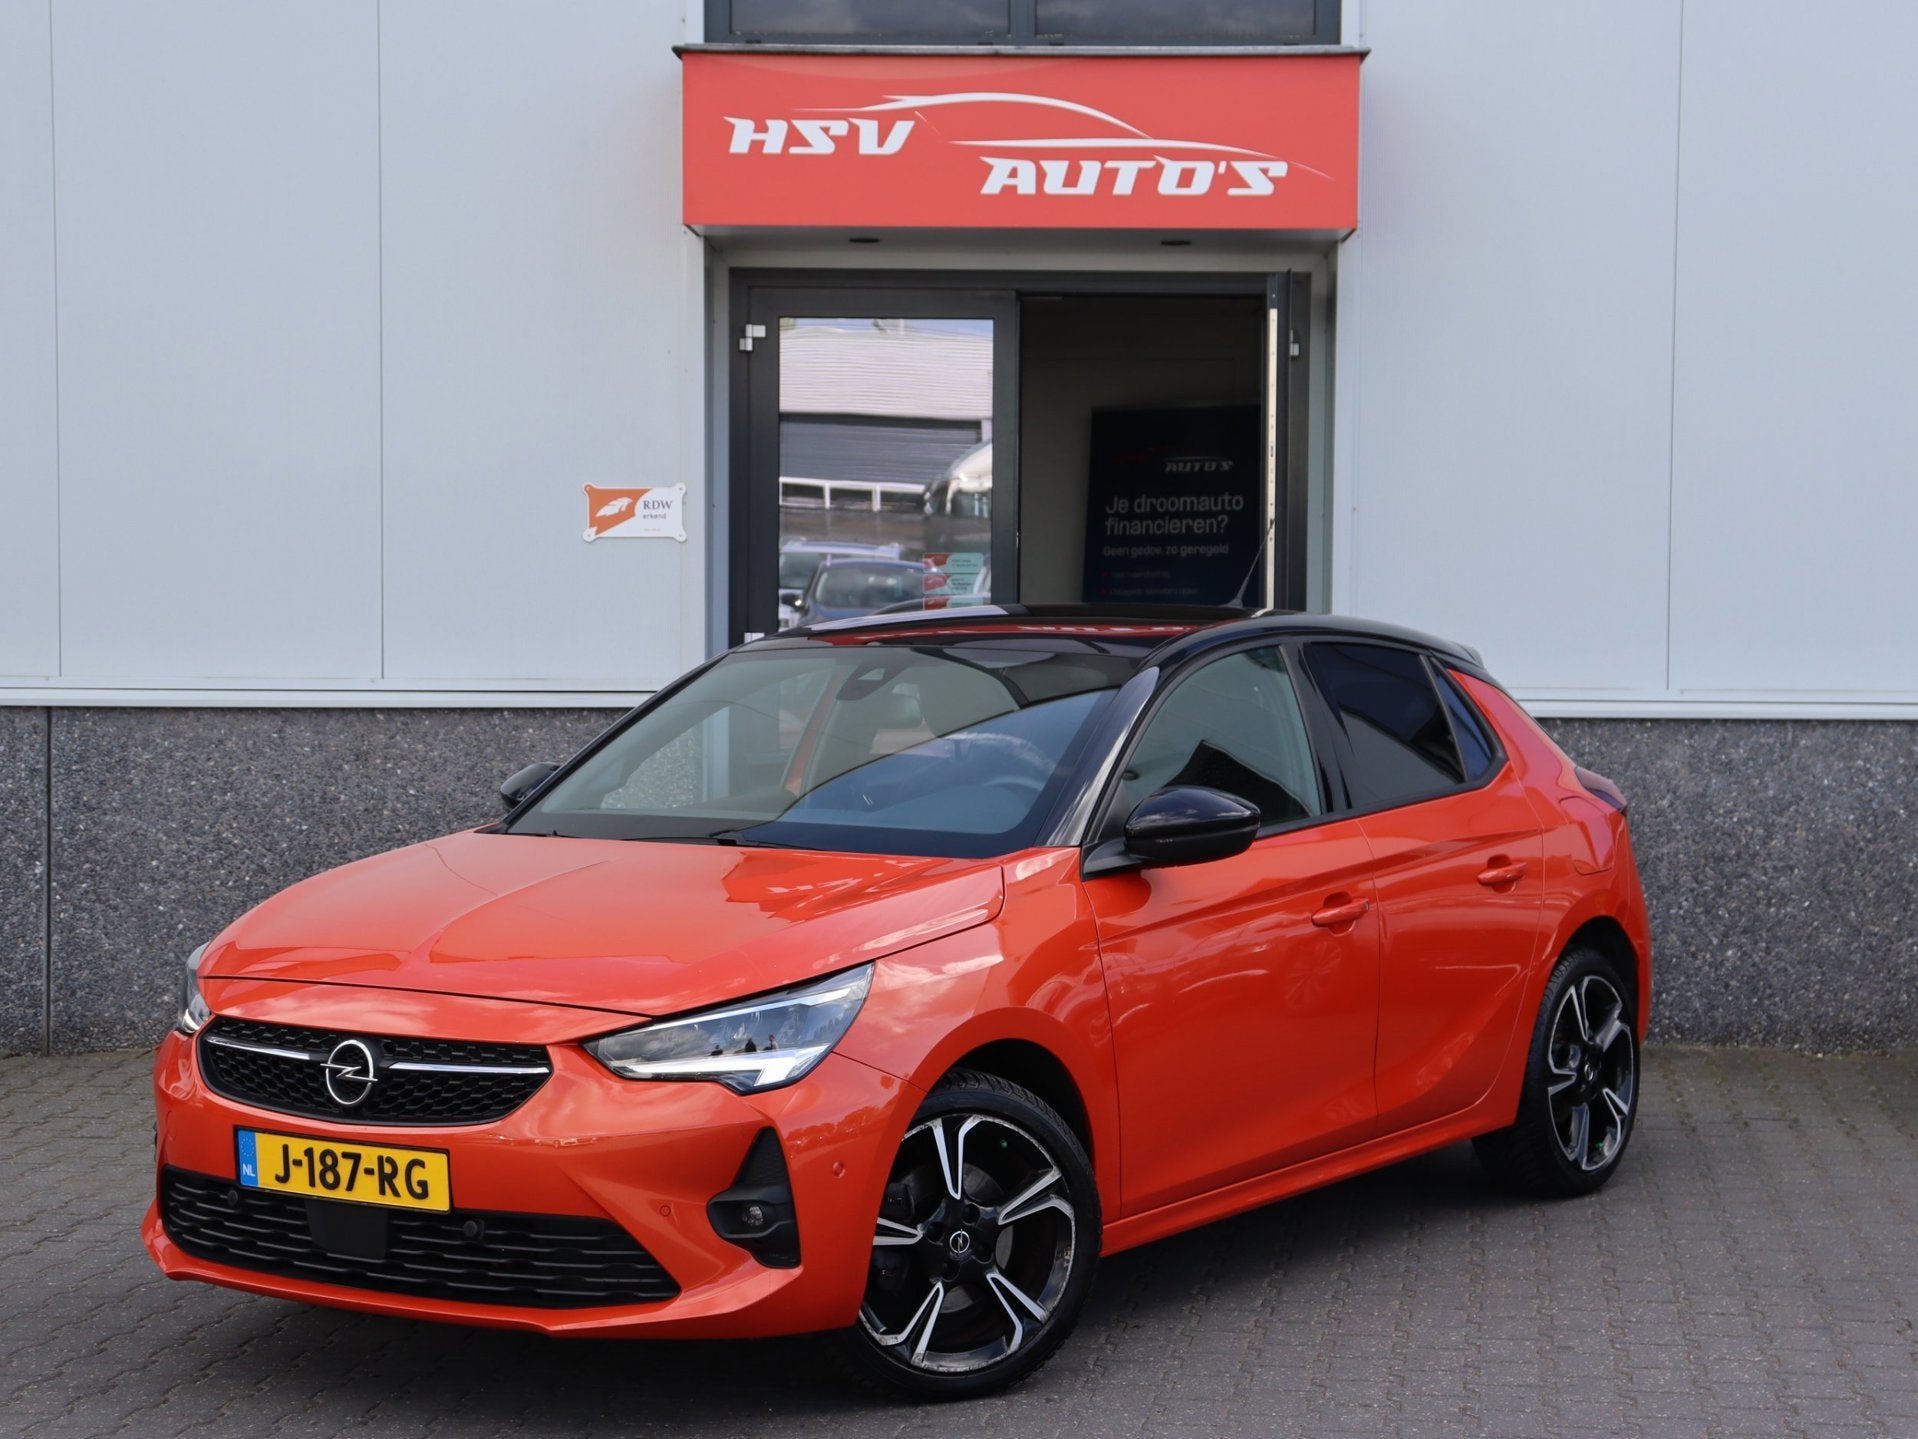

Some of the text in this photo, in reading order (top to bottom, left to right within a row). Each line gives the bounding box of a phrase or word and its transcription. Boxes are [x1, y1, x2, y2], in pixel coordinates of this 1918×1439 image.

[723, 116, 915, 155] HSV
[979, 155, 1289, 196] AUTO'S
[643, 500, 673, 510] RDW
[1105, 492, 1244, 514] Je droomauto
[1105, 515, 1229, 536] financieren?
[1103, 545, 1129, 556] Geen
[1180, 544, 1229, 557] geregeld
[242, 1163, 256, 1177] NL
[274, 1143, 429, 1201] J-187-RG
